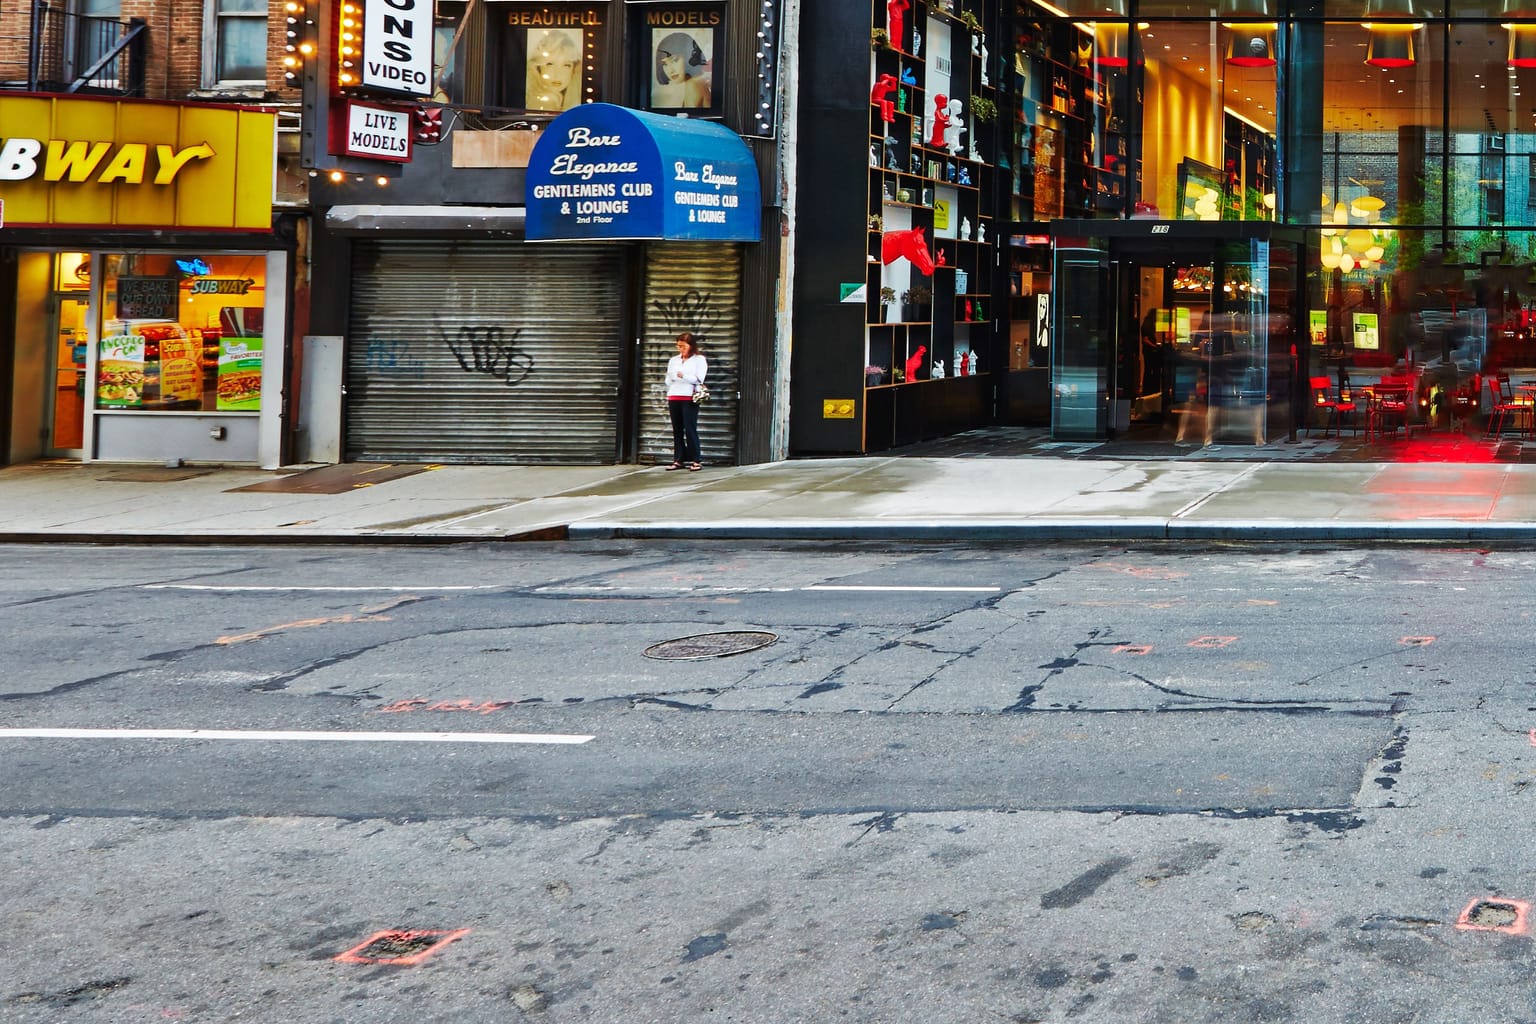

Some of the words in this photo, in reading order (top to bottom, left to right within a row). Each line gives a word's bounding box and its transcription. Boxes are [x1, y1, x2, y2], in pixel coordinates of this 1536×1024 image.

[508, 11, 602, 25] BEAUTIFUL
[646, 11, 720, 25] MODELS
[368, 61, 426, 85] VIDEO
[364, 112, 397, 131] LIVE
[351, 131, 407, 153] MODELS
[565, 127, 622, 148] Bare
[549, 153, 638, 180] Elegance
[674, 161, 699, 182] Bare
[701, 164, 738, 190] Elegance
[533, 183, 616, 199] GENTLEMENS
[621, 183, 654, 197] CLUB
[674, 191, 720, 207] GENTLEMENS
[722, 194, 739, 208] CLUB
[560, 201, 571, 215] &
[576, 201, 629, 214] LOUNGE
[689, 208, 696, 223] &
[697, 209, 727, 224] LOUNGE
[576, 216, 591, 224] 2nd
[593, 216, 614, 224] Floor
[123, 280, 139, 292] WE
[190, 279, 255, 295] SUBWAY
